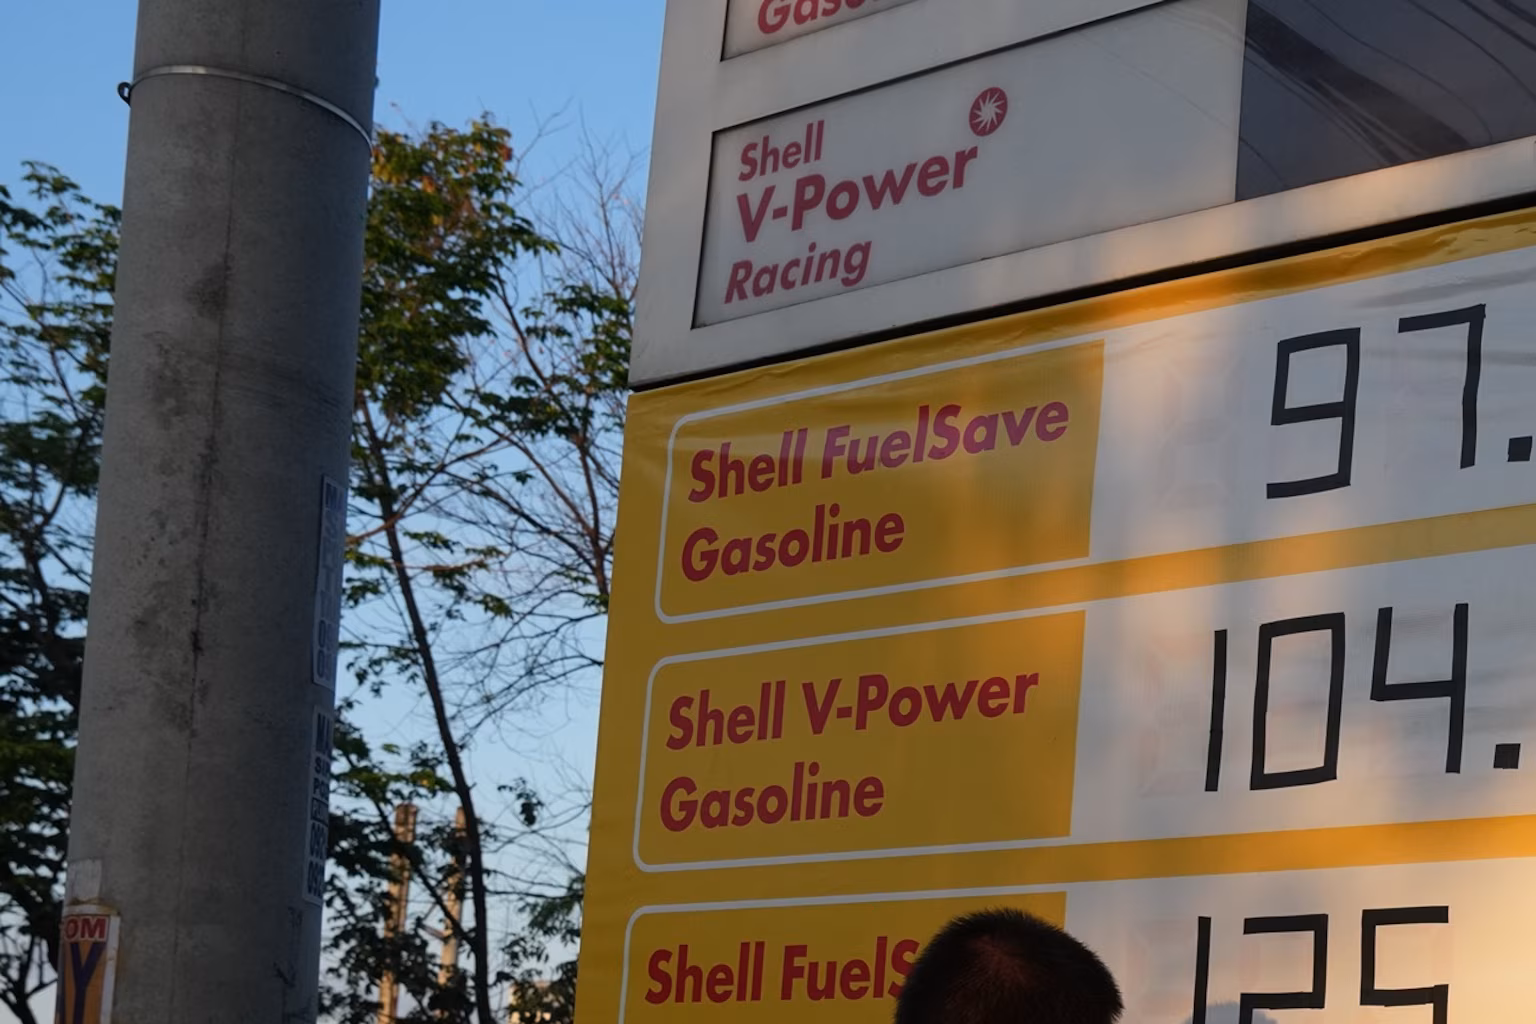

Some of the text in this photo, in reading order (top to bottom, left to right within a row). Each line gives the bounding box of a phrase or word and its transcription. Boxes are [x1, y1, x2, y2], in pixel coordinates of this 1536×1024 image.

[738, 120, 825, 182] Shell
[736, 145, 978, 243] V-Power
[724, 239, 872, 304] Racing
[687, 401, 1069, 503] Shell FuelSave
[681, 503, 905, 582] Gasoline
[666, 672, 1040, 751] Shell V-Power
[659, 761, 885, 832] Gasoline
[645, 941, 766, 1005] Shell
